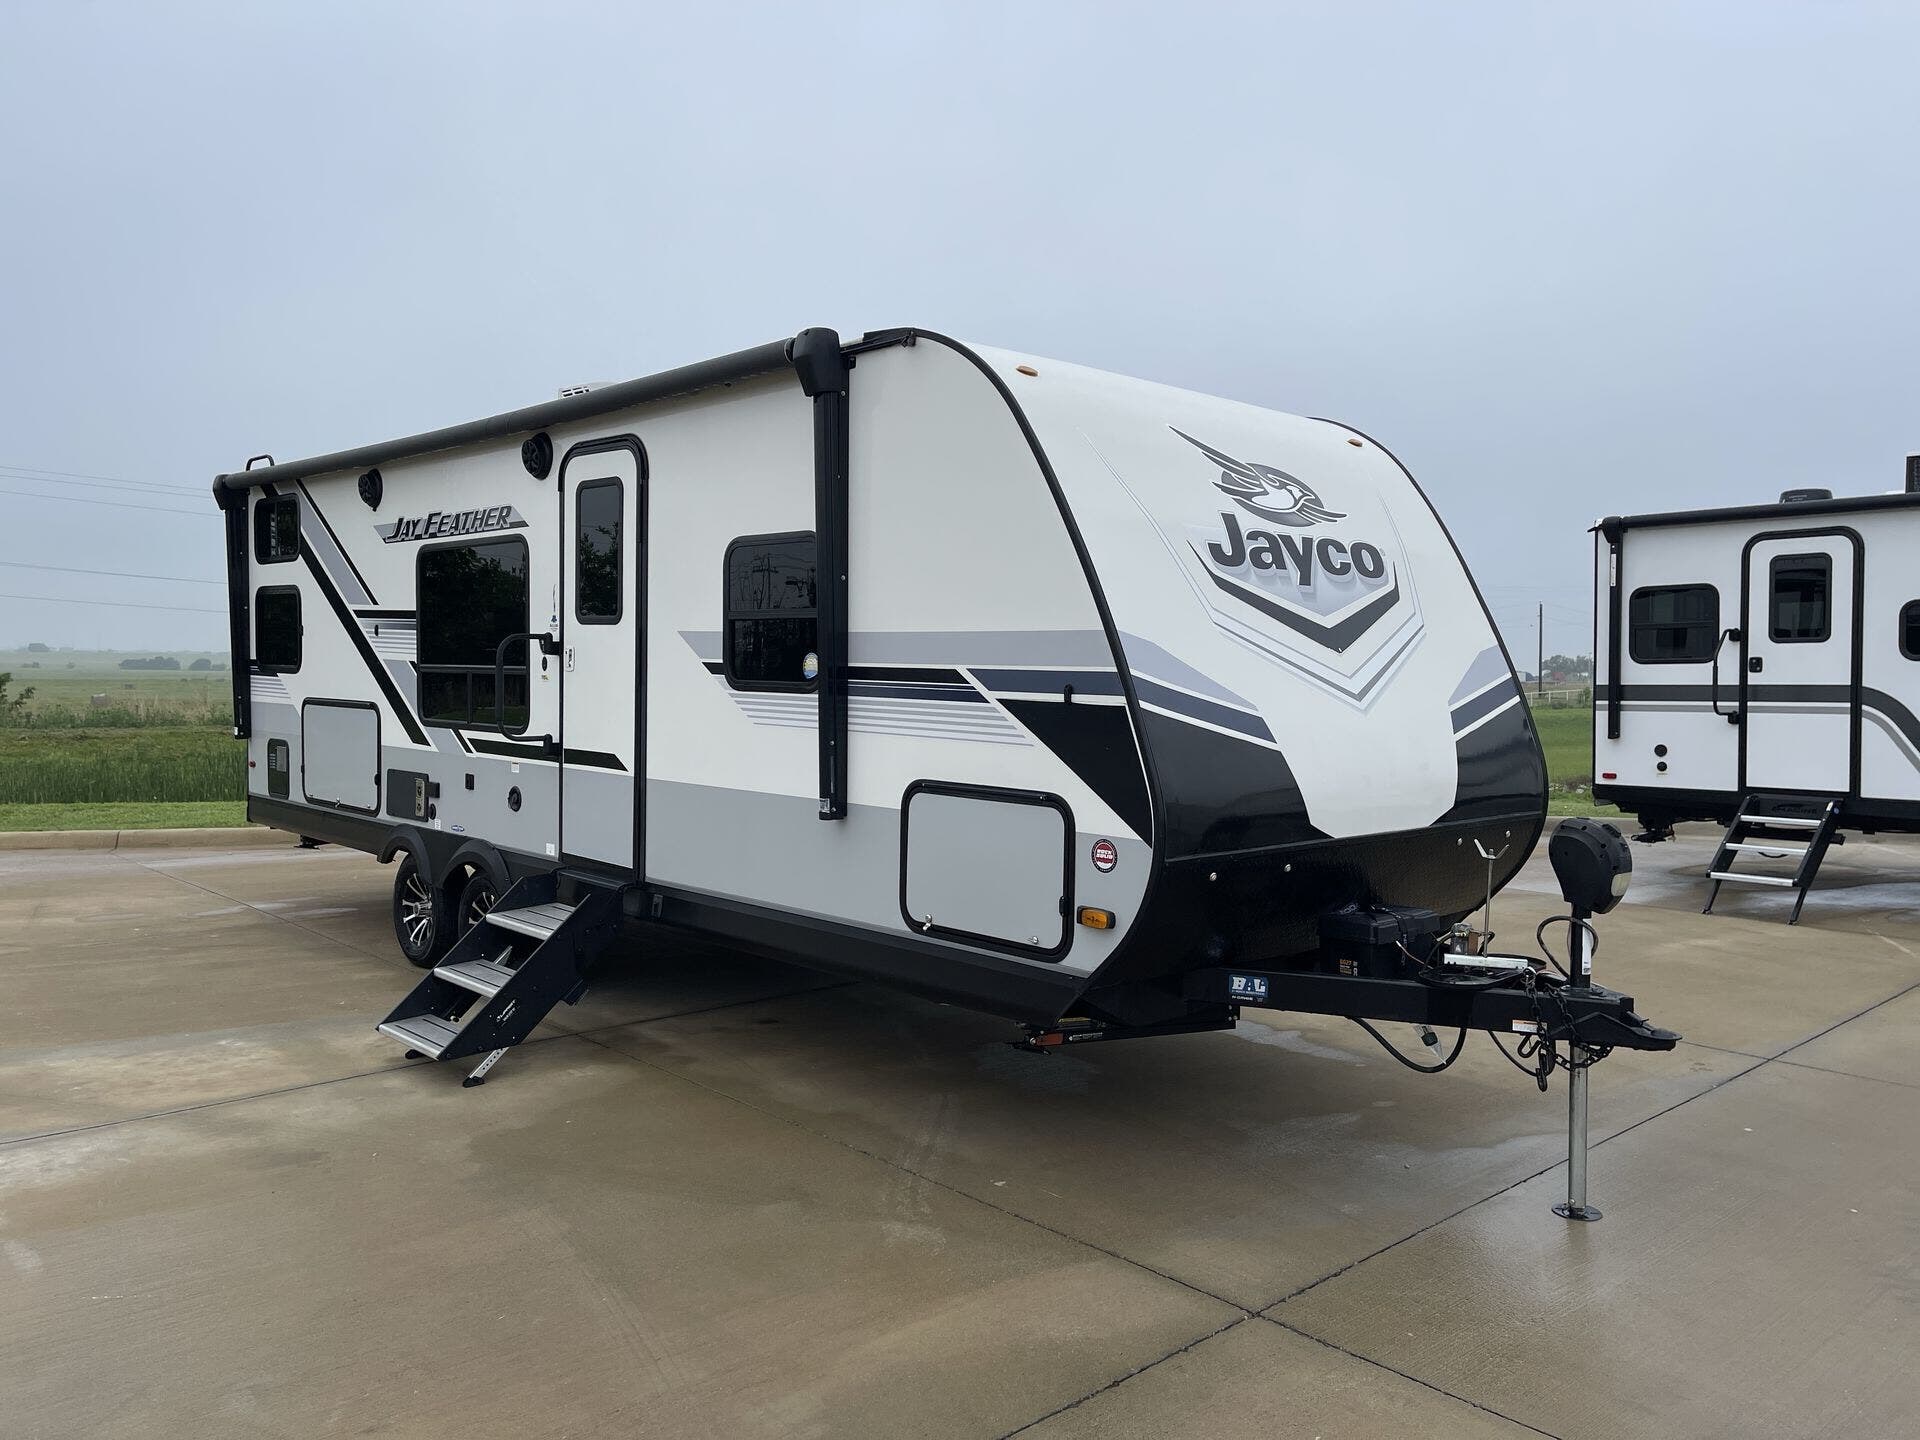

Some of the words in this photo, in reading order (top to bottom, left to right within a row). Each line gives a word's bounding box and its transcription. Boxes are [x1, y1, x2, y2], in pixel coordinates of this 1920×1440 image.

[386, 517, 422, 540] JAY
[423, 505, 512, 536] FEATHER
[1207, 512, 1385, 587] Jayco
